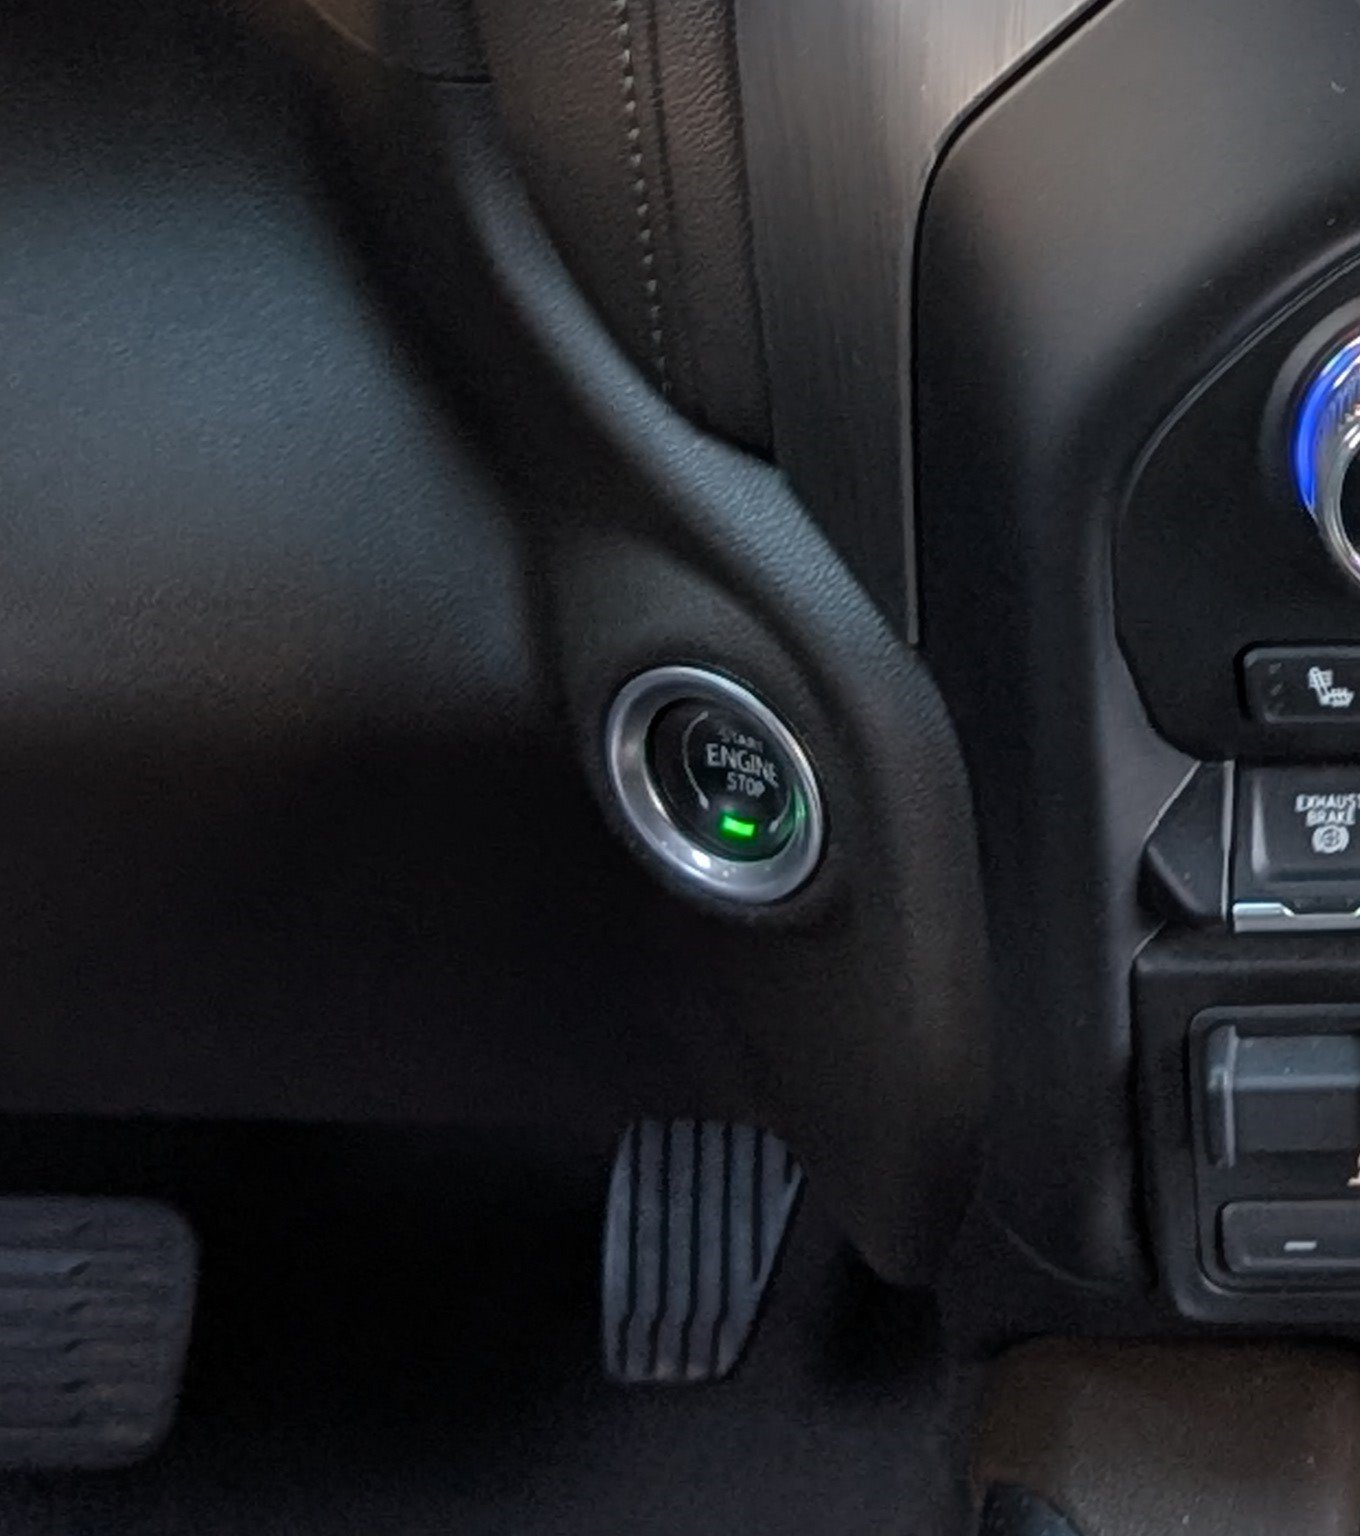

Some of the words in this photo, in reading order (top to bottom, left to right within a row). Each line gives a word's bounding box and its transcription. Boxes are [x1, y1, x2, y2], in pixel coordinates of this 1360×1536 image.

[705, 743, 779, 788] ENGINE
[727, 772, 765, 797] STOP
[1306, 809, 1355, 827] BRAKE
